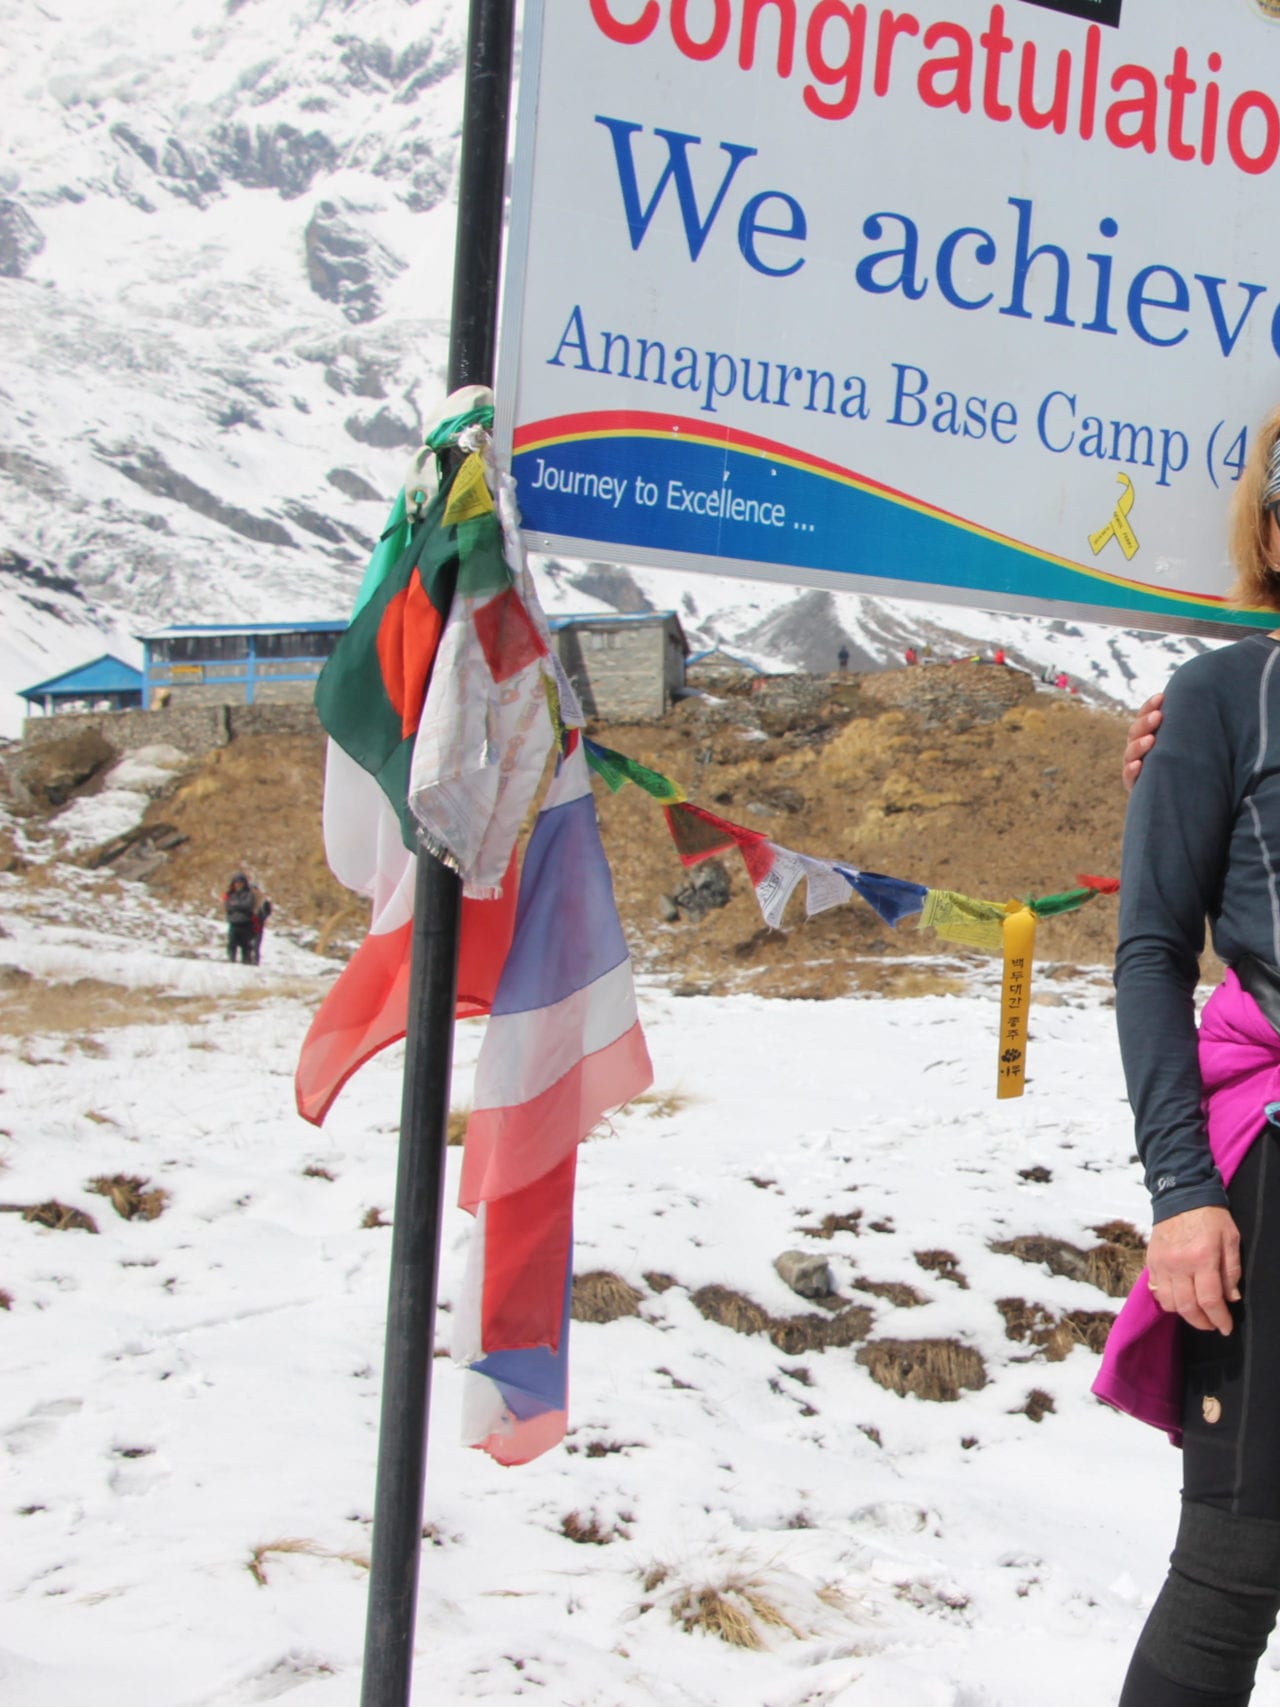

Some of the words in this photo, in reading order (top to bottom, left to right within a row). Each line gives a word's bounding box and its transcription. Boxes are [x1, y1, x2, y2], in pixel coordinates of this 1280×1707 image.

[594, 114, 808, 277] We
[546, 304, 870, 421] Annapurna
[886, 362, 1019, 444] Base
[1037, 390, 1189, 486] Camp
[1207, 420, 1248, 489] (4
[531, 458, 628, 508] Journey
[635, 476, 658, 506] to
[666, 480, 785, 527] Excellence
[1009, 958, 1024, 1008] 백두대간
